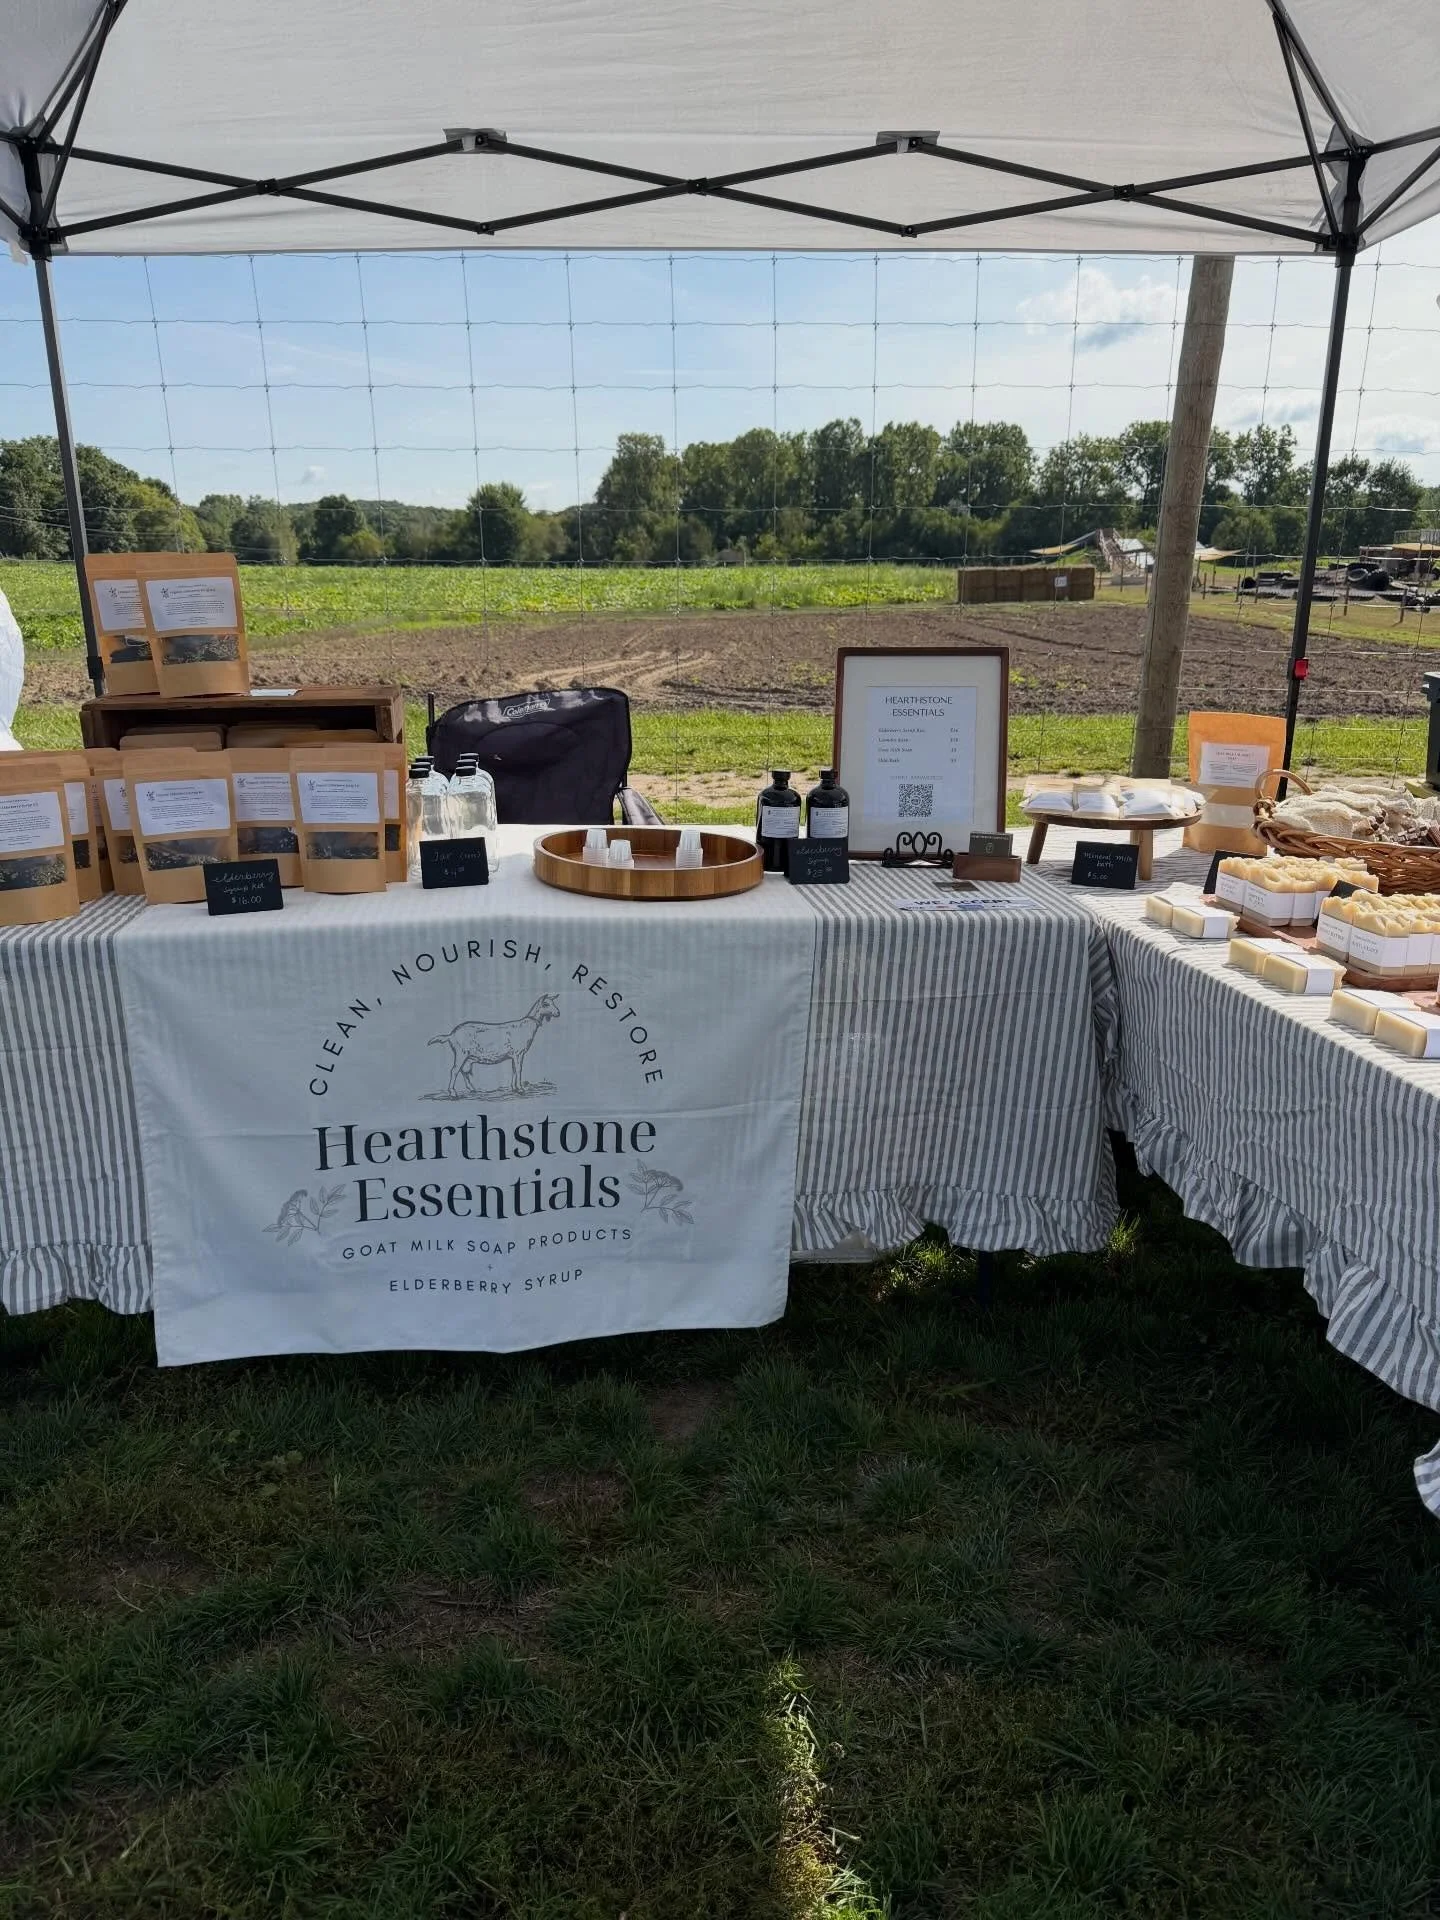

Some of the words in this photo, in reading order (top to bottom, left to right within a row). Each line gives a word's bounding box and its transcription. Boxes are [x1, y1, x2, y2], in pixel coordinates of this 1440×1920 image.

[885, 696, 953, 705] HEARTHSTONE
[892, 708, 945, 717] ESSENTIALS
[308, 997, 383, 1097] CLEAN,
[391, 938, 552, 985] NOURISH,
[571, 963, 664, 1085] RESTORE
[312, 1113, 658, 1172] Hearthstone
[349, 1164, 621, 1223] Essentials
[342, 1241, 397, 1260] GOAT
[410, 1239, 455, 1252] MILK
[466, 1239, 516, 1255] SOAP
[528, 1228, 632, 1250] PRODUCTS
[389, 1278, 512, 1295] ELDERBERRY
[524, 1268, 583, 1292] SYRUP
